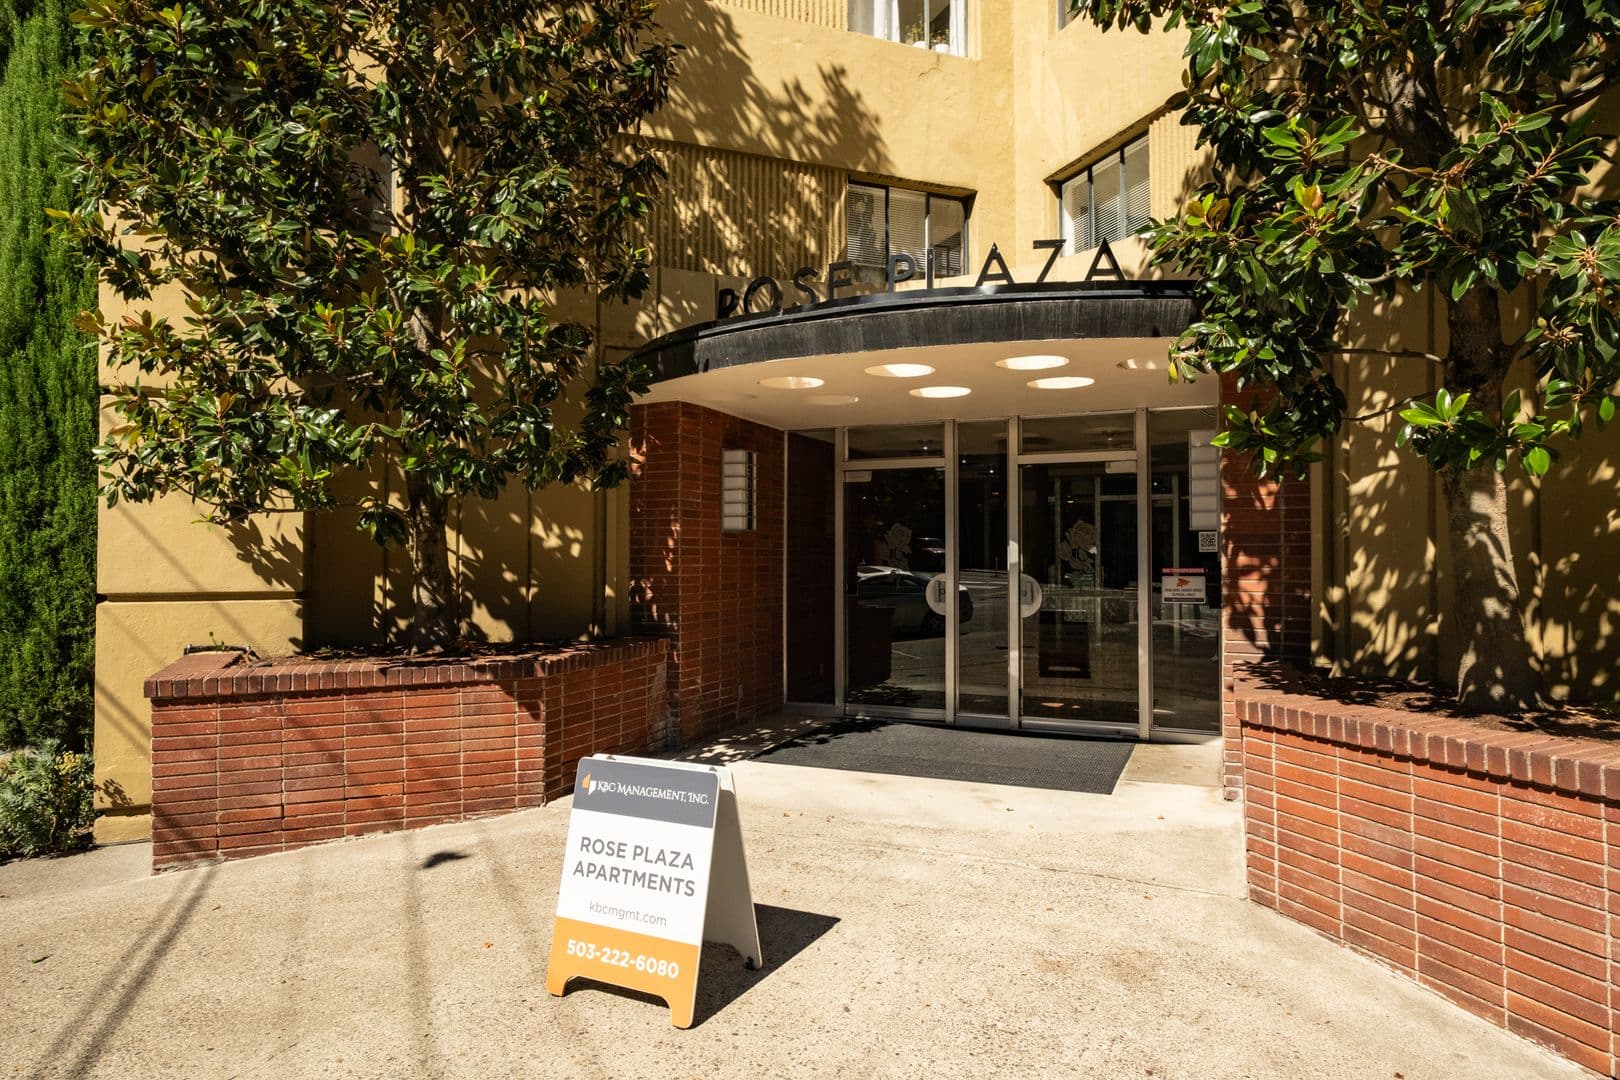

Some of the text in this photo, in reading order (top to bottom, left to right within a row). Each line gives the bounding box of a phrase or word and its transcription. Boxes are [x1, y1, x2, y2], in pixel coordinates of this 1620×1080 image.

[718, 237, 1126, 319] ROSE PLAZA
[597, 780, 710, 805] KBC MANAGEMENT, INC.
[580, 836, 694, 871] ROSE PLAZA
[573, 860, 696, 897] APARTMENTS
[589, 900, 667, 926] kbcmgmt.com
[567, 938, 680, 979] 503-222-6080
